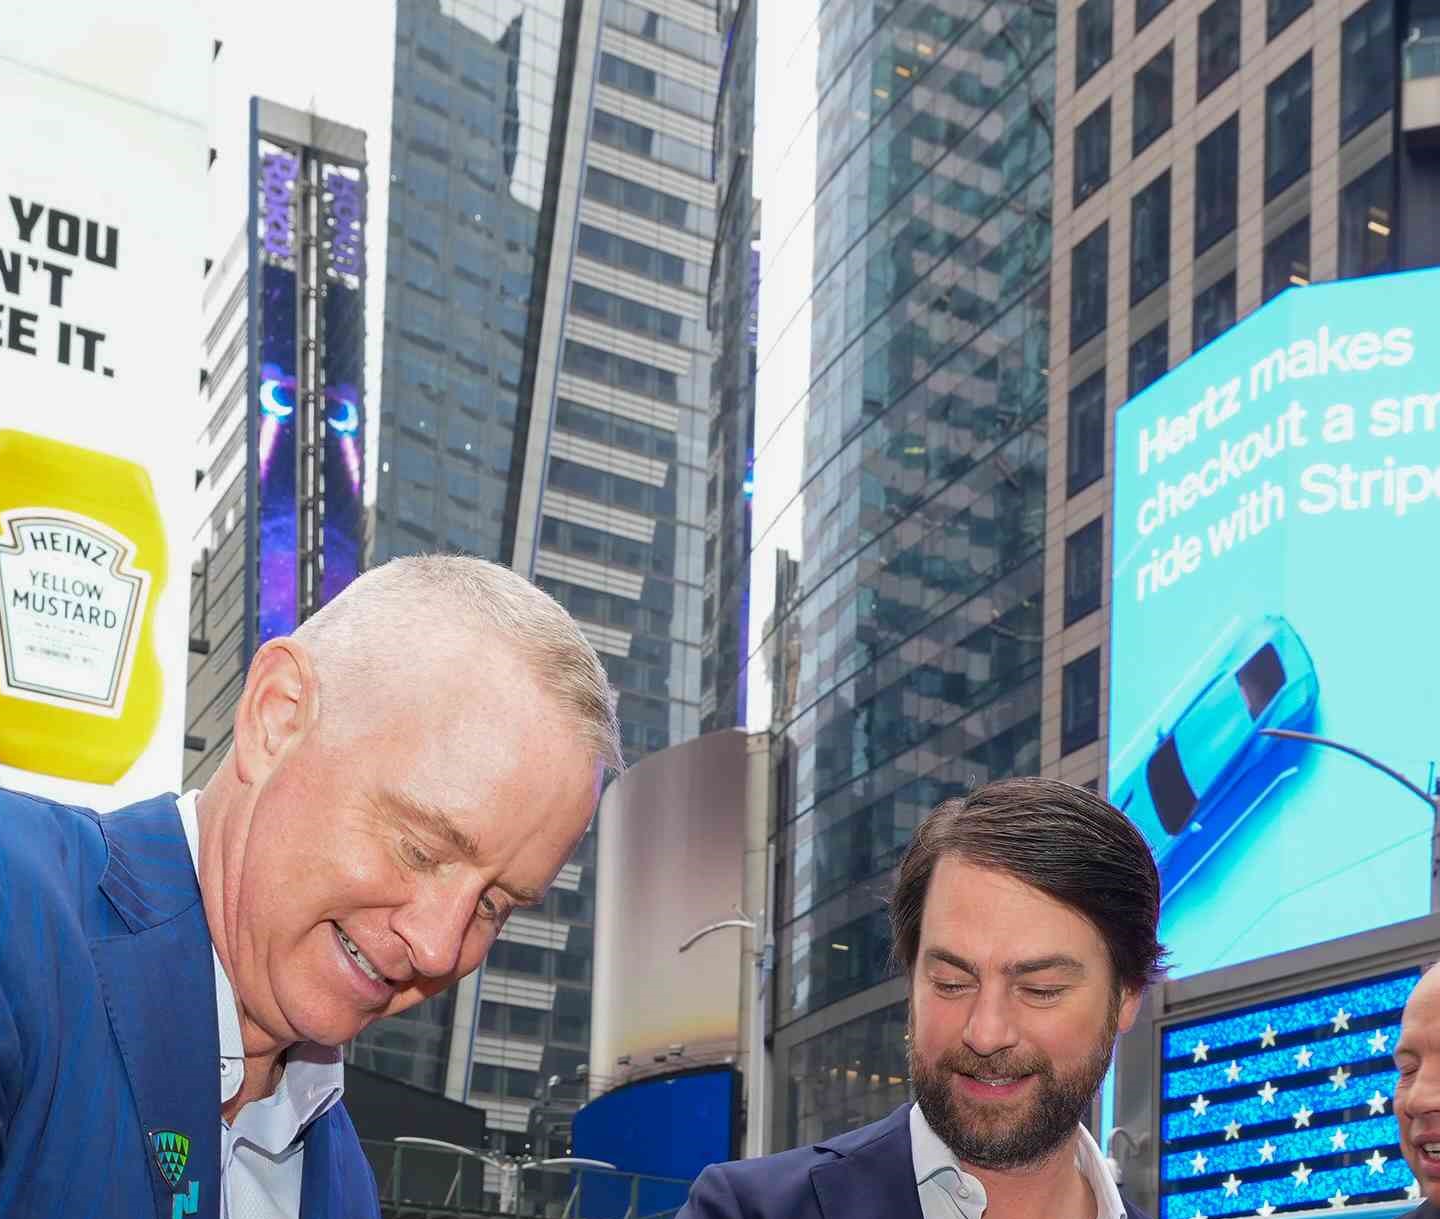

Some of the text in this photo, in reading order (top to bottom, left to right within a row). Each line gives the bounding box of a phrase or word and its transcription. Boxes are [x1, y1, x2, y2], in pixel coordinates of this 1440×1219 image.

[9, 195, 118, 269] YOU
[58, 321, 114, 378] IT.
[1138, 325, 1414, 475] Hertz makes
[1136, 401, 1308, 536] checkout
[1322, 403, 1355, 443] a
[30, 531, 108, 566] HEINZ
[1136, 534, 1202, 602] ride
[1208, 481, 1285, 557] with
[13, 589, 117, 629] MUSTARD
[29, 569, 104, 601] YELLOW
